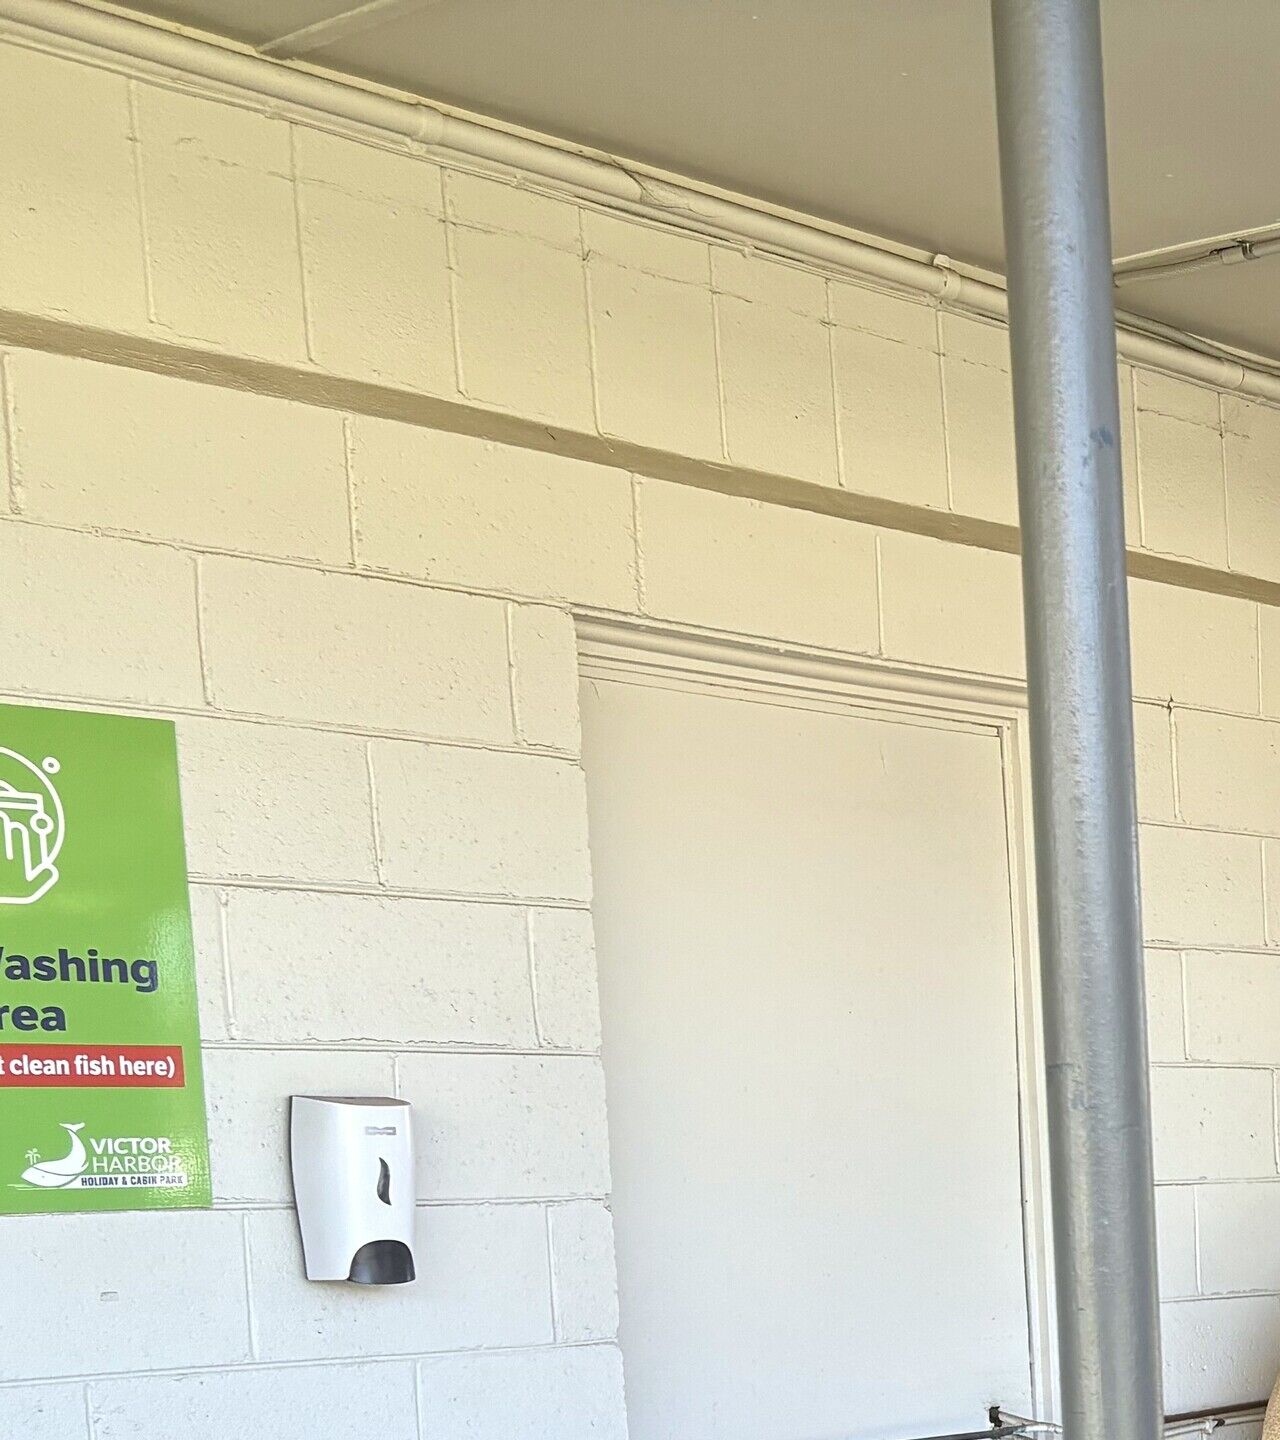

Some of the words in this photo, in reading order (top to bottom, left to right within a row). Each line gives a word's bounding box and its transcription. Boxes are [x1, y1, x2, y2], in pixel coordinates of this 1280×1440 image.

[0, 946, 158, 993] ashing
[0, 1004, 67, 1032] rea
[9, 1053, 71, 1076] clean
[74, 1054, 113, 1076] fish
[118, 1055, 175, 1079] here)
[89, 1137, 173, 1155] VICTOR
[92, 1154, 183, 1174] HARBOR
[80, 1176, 119, 1187] HOLIDAY
[121, 1176, 128, 1186] &
[130, 1175, 157, 1186] CABIN
[159, 1174, 184, 1185] PARK
